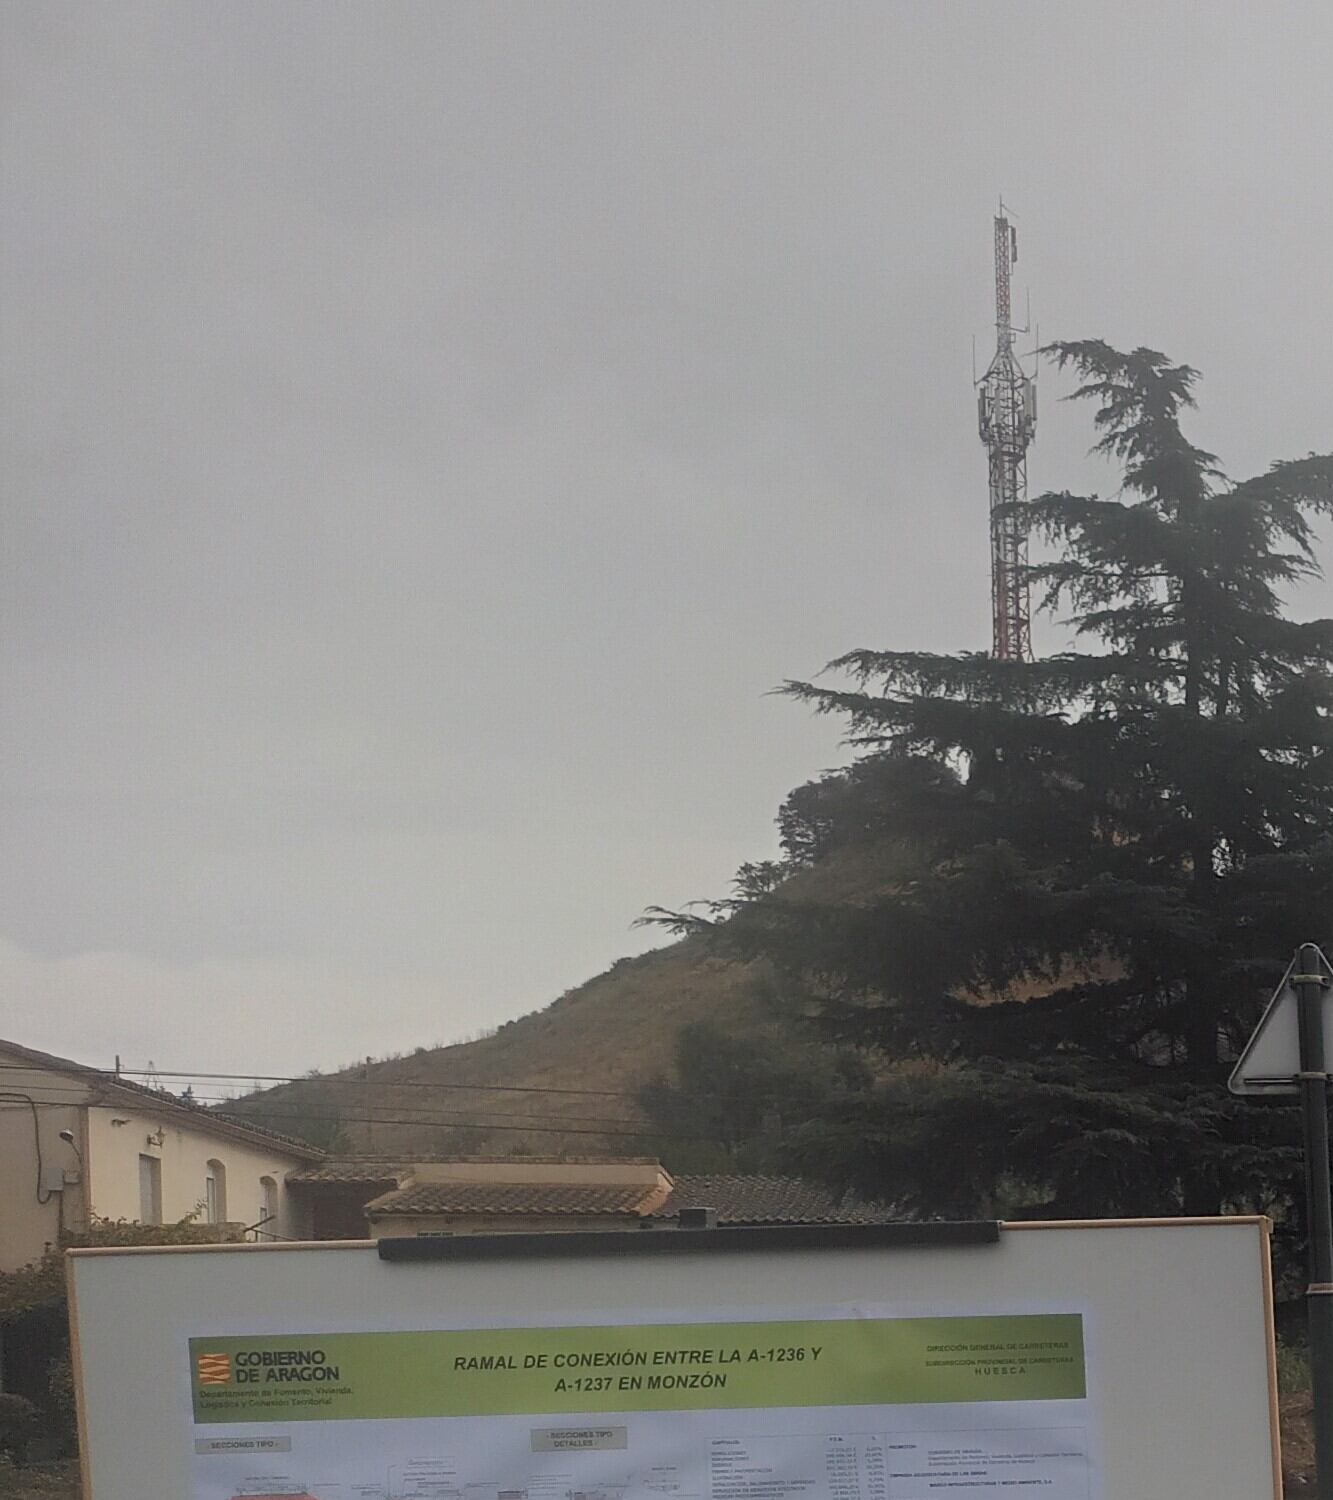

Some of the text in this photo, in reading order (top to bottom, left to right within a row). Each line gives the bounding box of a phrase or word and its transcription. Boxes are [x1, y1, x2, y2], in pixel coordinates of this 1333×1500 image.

[235, 1350, 326, 1367] GOBIERNO
[454, 1347, 822, 1370] RAMAL DE CONEXIÓN ENTRE LA A-1236 Y
[236, 1366, 340, 1383] DE ARAGON
[974, 1367, 1026, 1376] HUESCA
[554, 1371, 727, 1392] A-1237 EN MONZÓN
